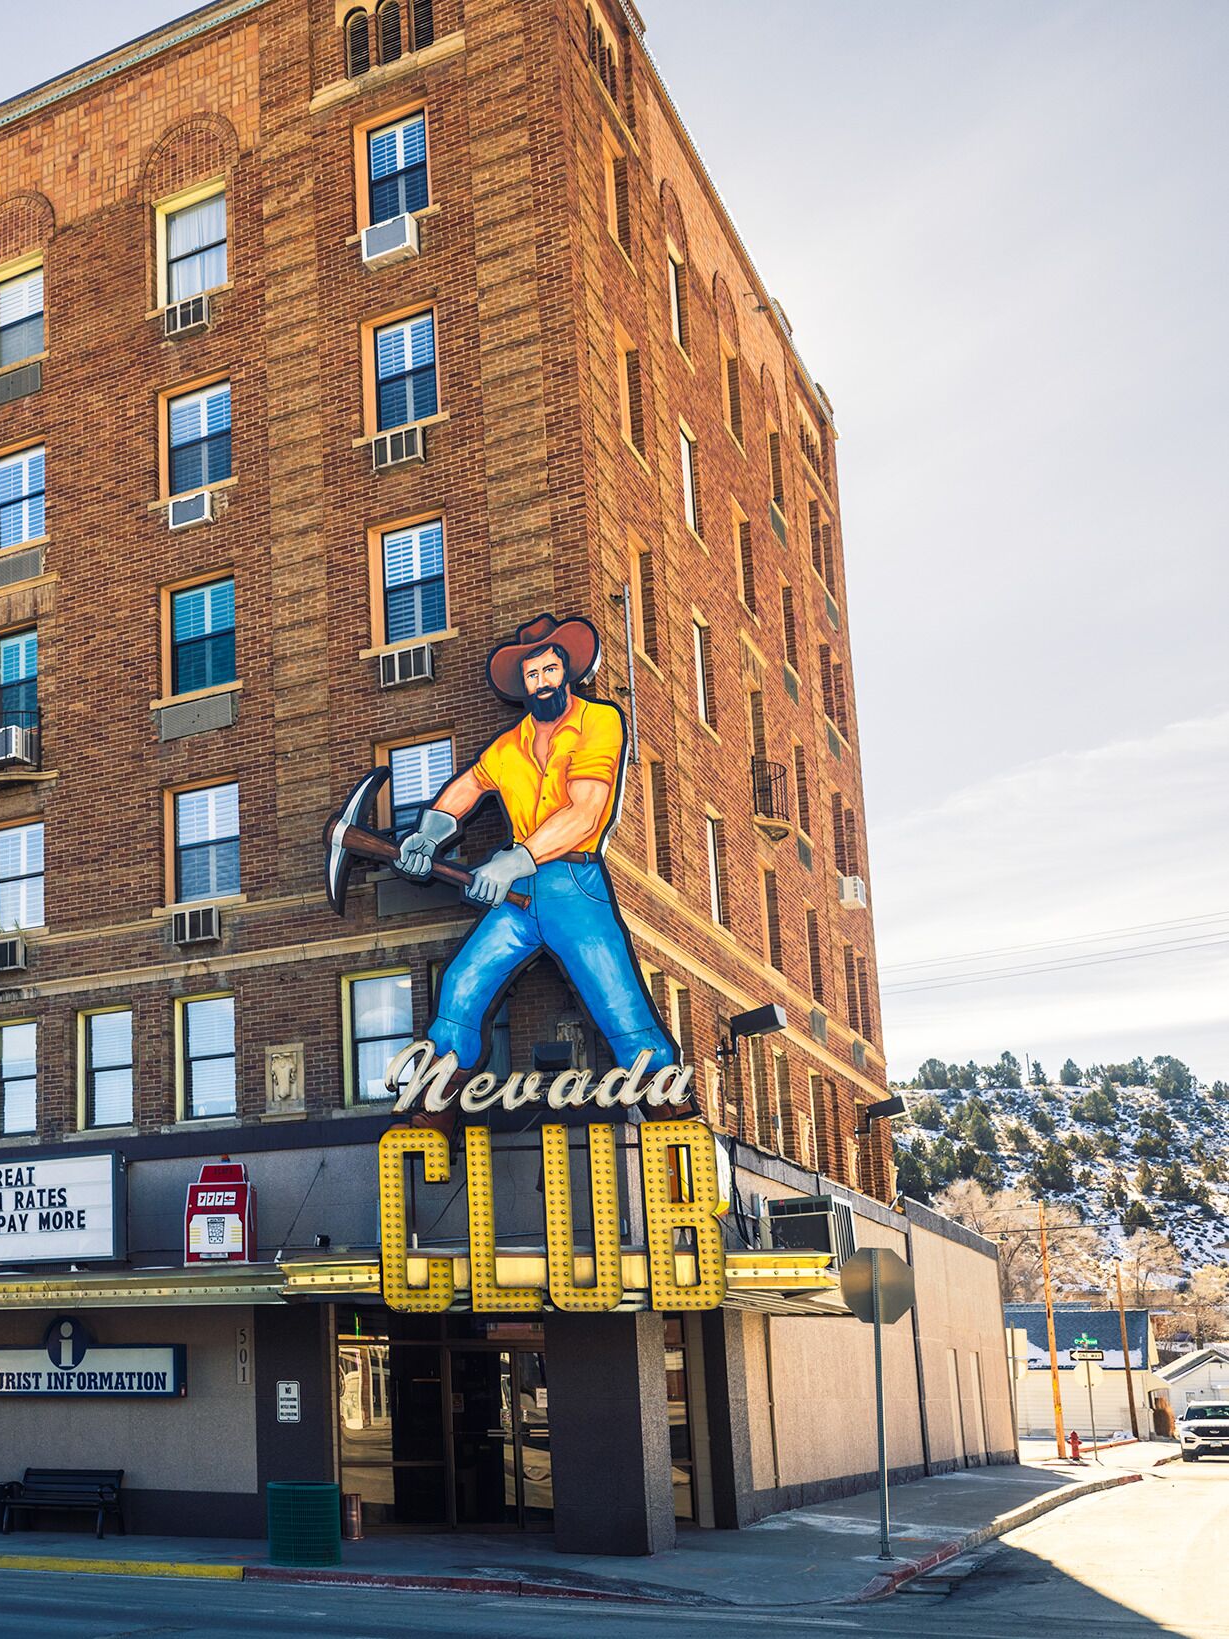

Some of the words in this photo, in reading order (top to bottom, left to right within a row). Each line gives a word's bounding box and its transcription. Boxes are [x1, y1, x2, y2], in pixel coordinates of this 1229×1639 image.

[385, 1039, 693, 1114] Nevada
[14, 1188, 68, 1210] RATES
[379, 1120, 727, 1313] CLUB
[38, 1209, 86, 1231] MORE
[239, 1328, 248, 1382] 501
[46, 1371, 167, 1391] INFORMATION
